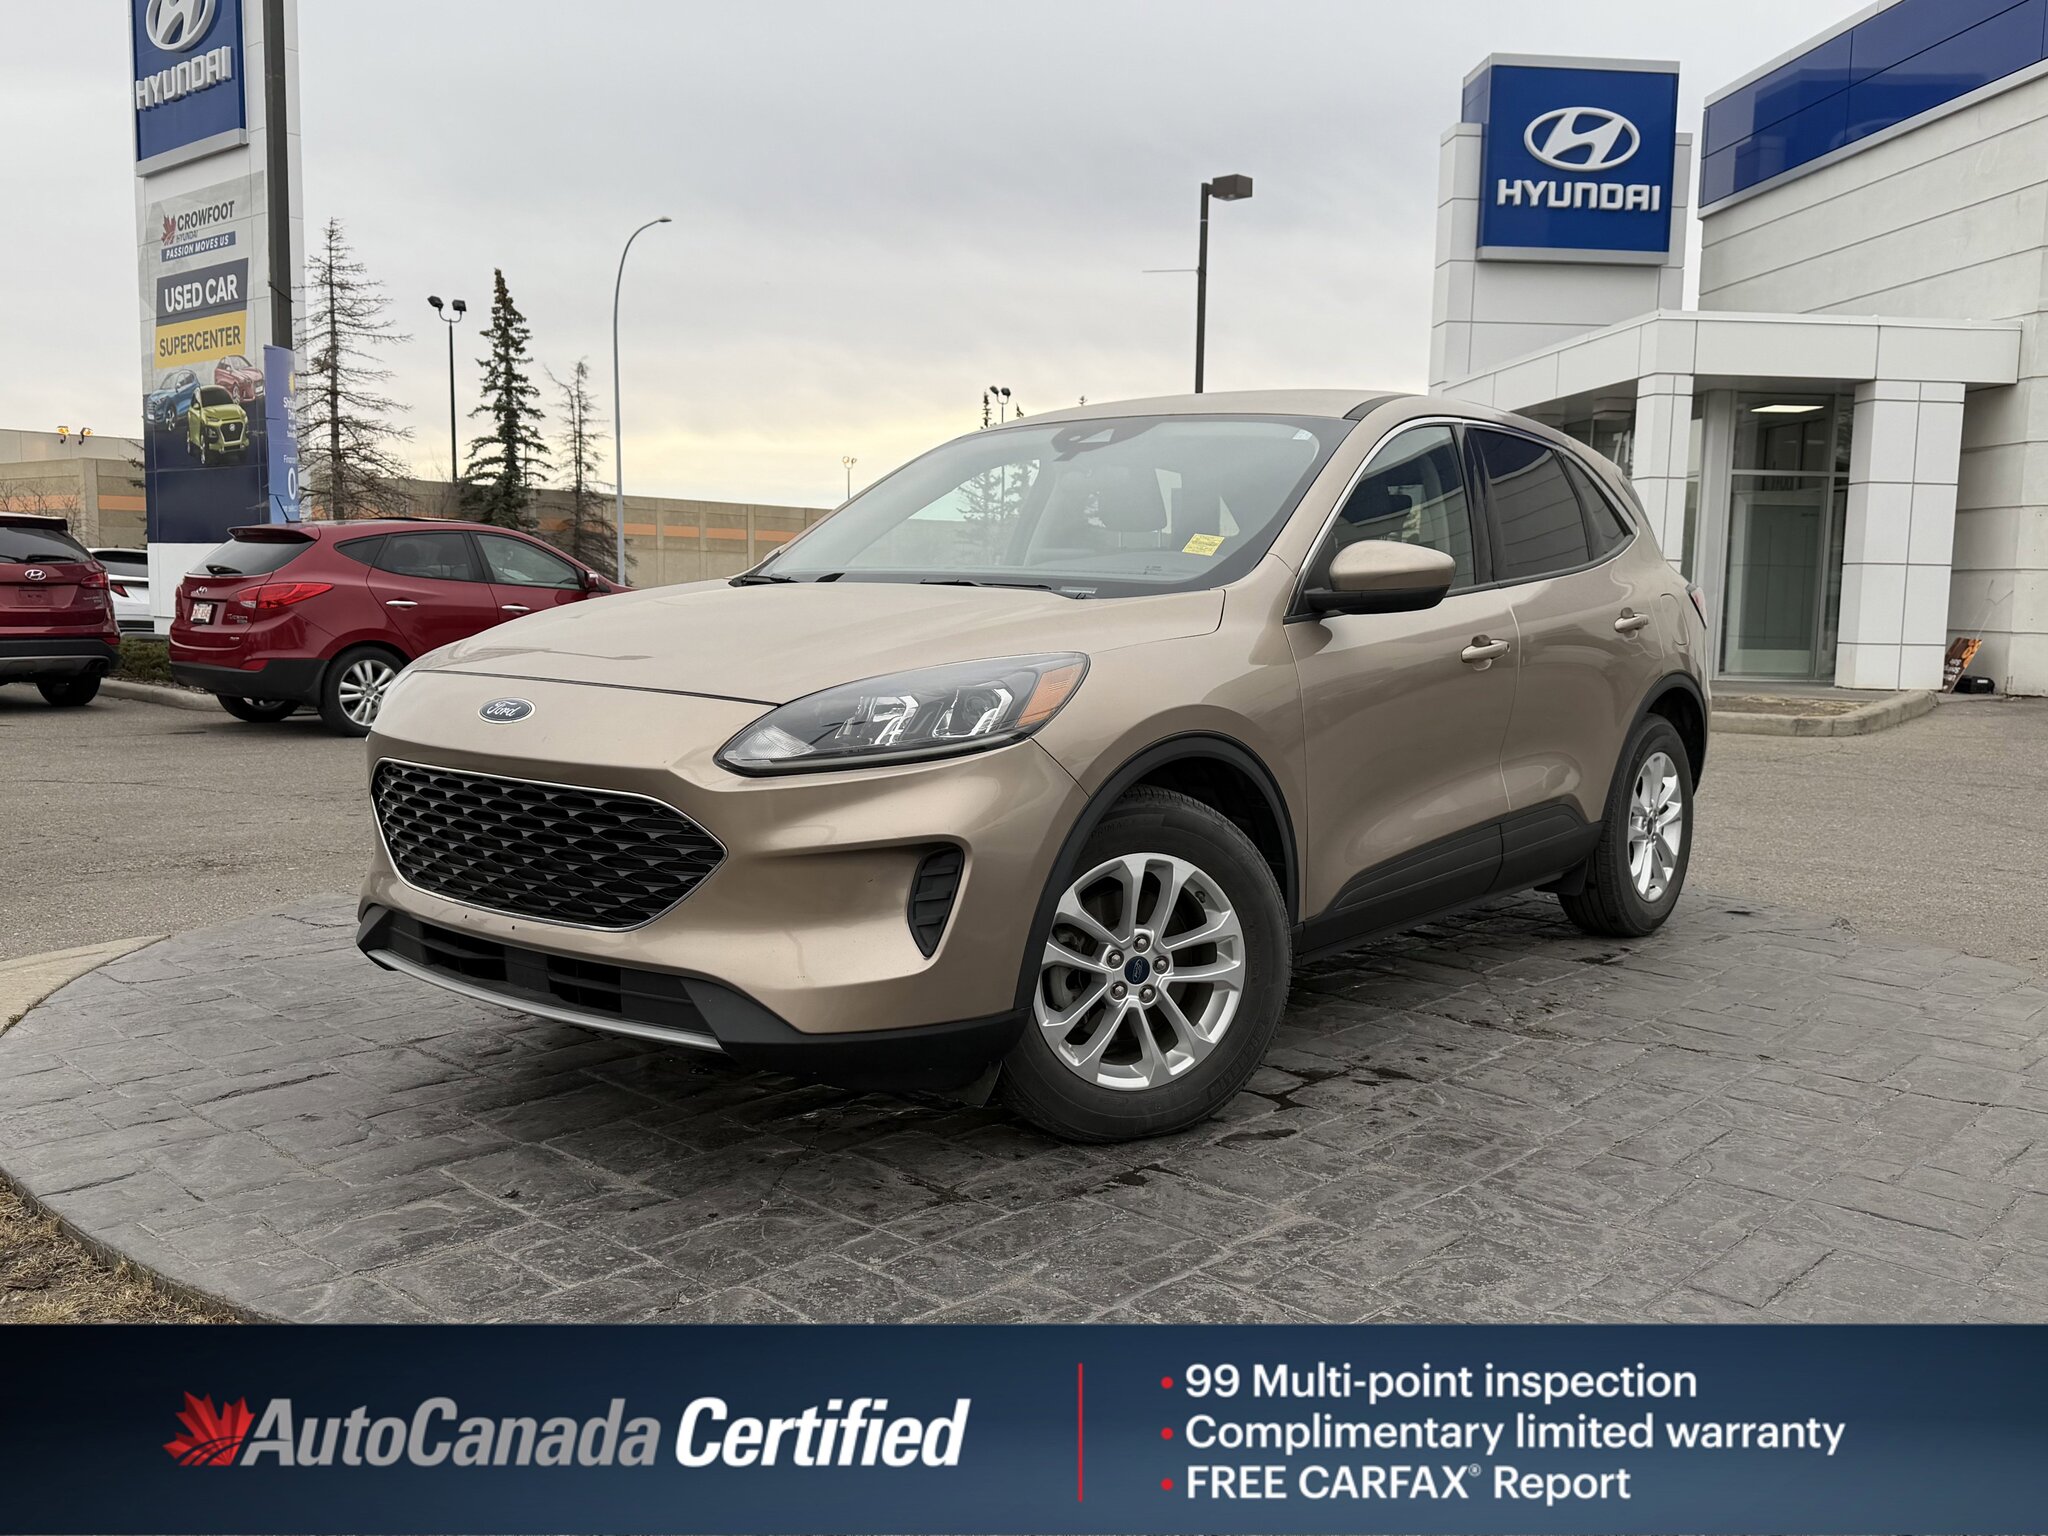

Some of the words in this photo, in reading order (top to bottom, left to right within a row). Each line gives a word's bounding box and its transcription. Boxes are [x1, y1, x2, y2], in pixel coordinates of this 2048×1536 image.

[136, 46, 231, 110] HYUNDAI
[1496, 178, 1660, 212] HYUNDAI
[177, 201, 235, 231] CROWFOOT
[166, 244, 194, 260] PASSION
[195, 237, 219, 253] MOVES
[219, 234, 229, 246] US
[164, 282, 203, 312] USED
[205, 274, 239, 305] CAR
[159, 325, 241, 357] SUPERCENTER
[486, 701, 522, 717] Ford
